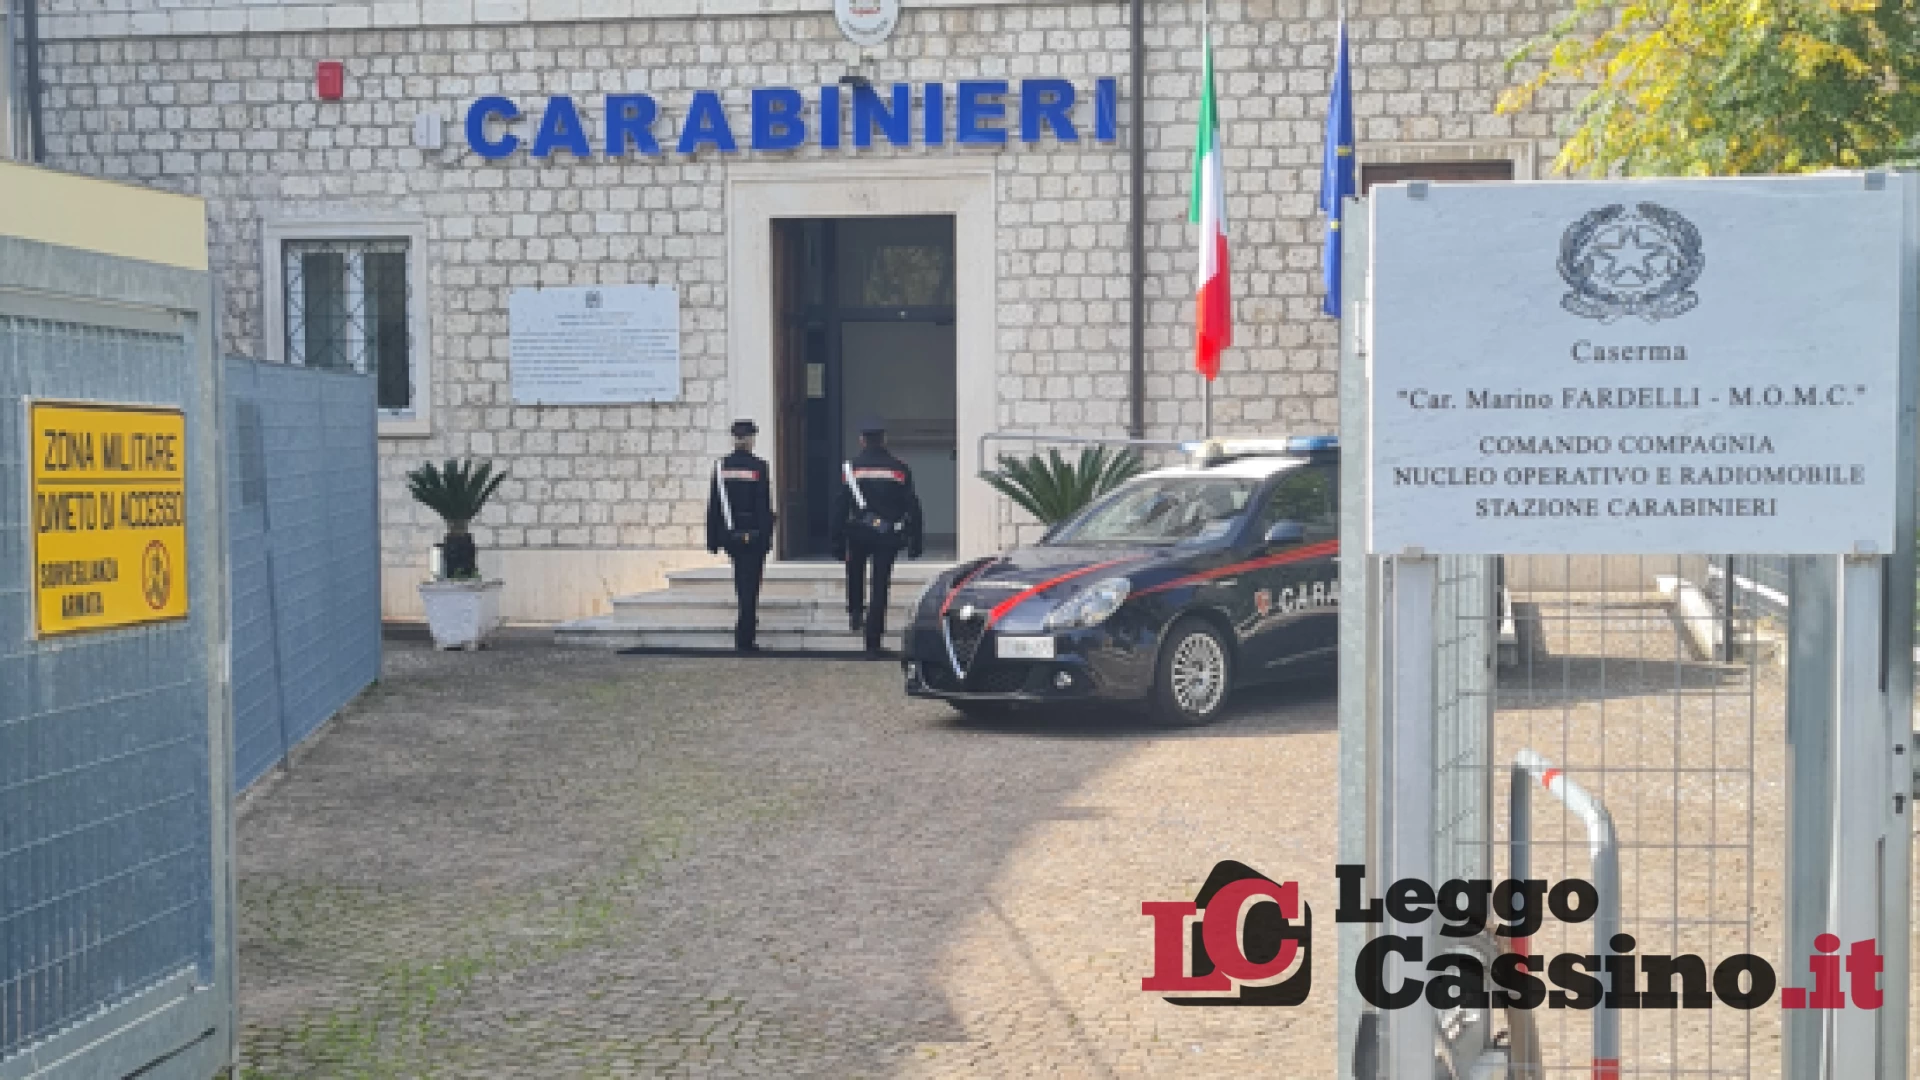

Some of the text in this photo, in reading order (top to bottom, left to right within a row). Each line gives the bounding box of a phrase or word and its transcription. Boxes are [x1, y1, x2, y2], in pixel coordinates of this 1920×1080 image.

[465, 77, 1116, 158] CARABINIERI
[1570, 339, 1688, 363] Caserma
[1466, 389, 1553, 410] Marino
[1561, 387, 1700, 409] FARDELLI
[44, 429, 177, 471] ZONA MILITARE
[1478, 434, 1775, 456] COMANDO COMPAGNIA
[1393, 465, 1866, 487] NUCLEO OPERATIVO E RADIOMOBILE
[38, 490, 184, 533] DIVIETO DI ACCESSO
[1475, 497, 1778, 518] STAZIONE CARABINIERI
